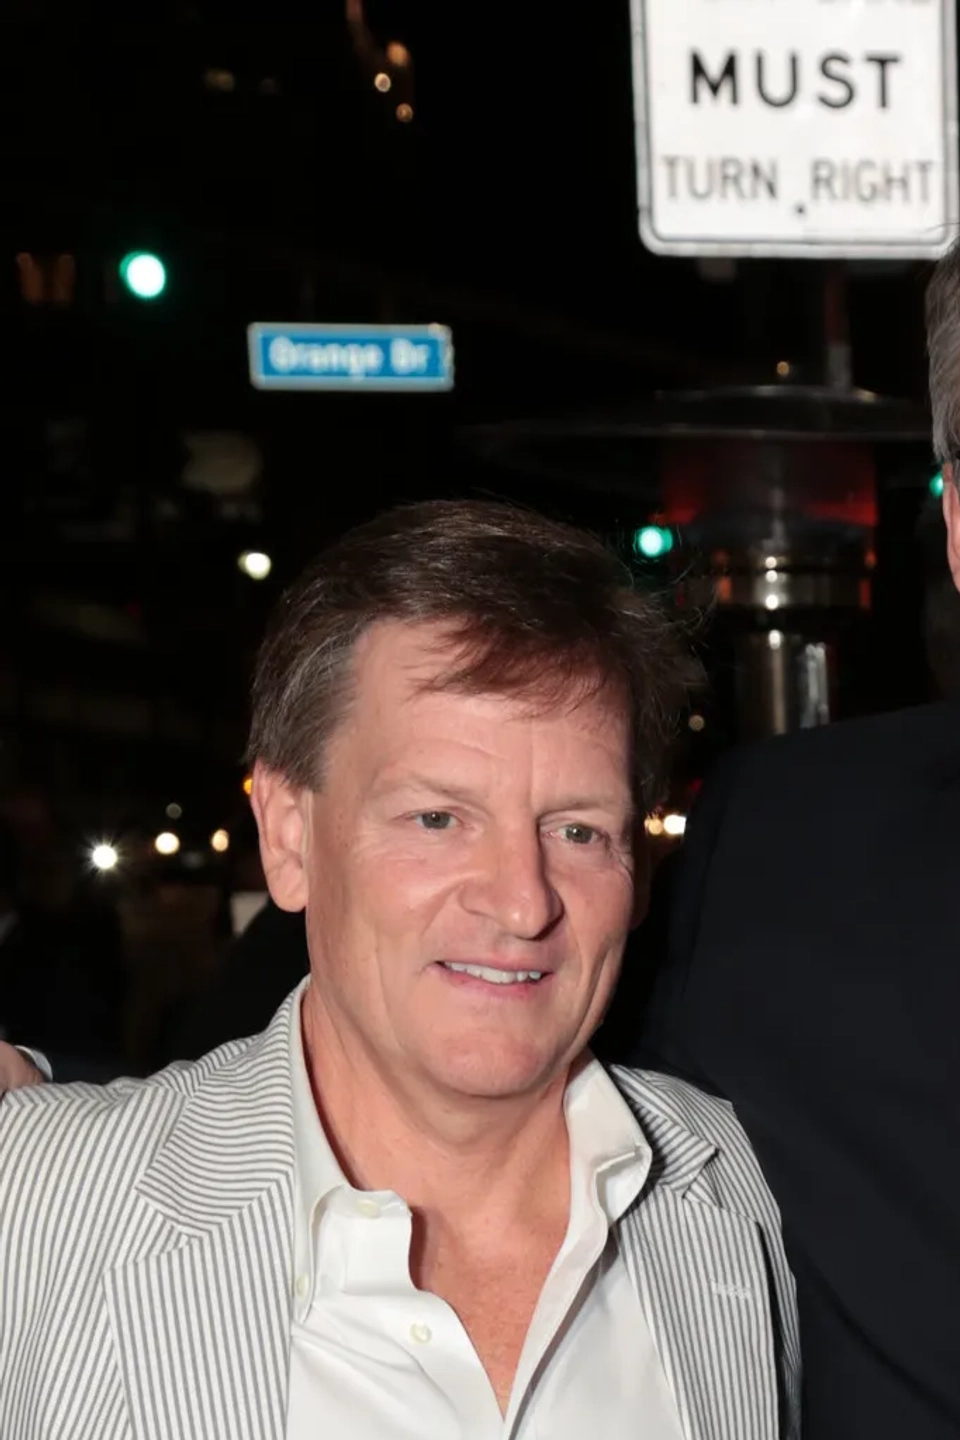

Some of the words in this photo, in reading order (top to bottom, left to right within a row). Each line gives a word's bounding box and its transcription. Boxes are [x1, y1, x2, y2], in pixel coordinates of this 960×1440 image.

[690, 50, 903, 109] MUST
[661, 154, 779, 201] TURN
[810, 158, 934, 203] RIGHT
[268, 336, 384, 381] Orange
[390, 337, 430, 375] Dr
